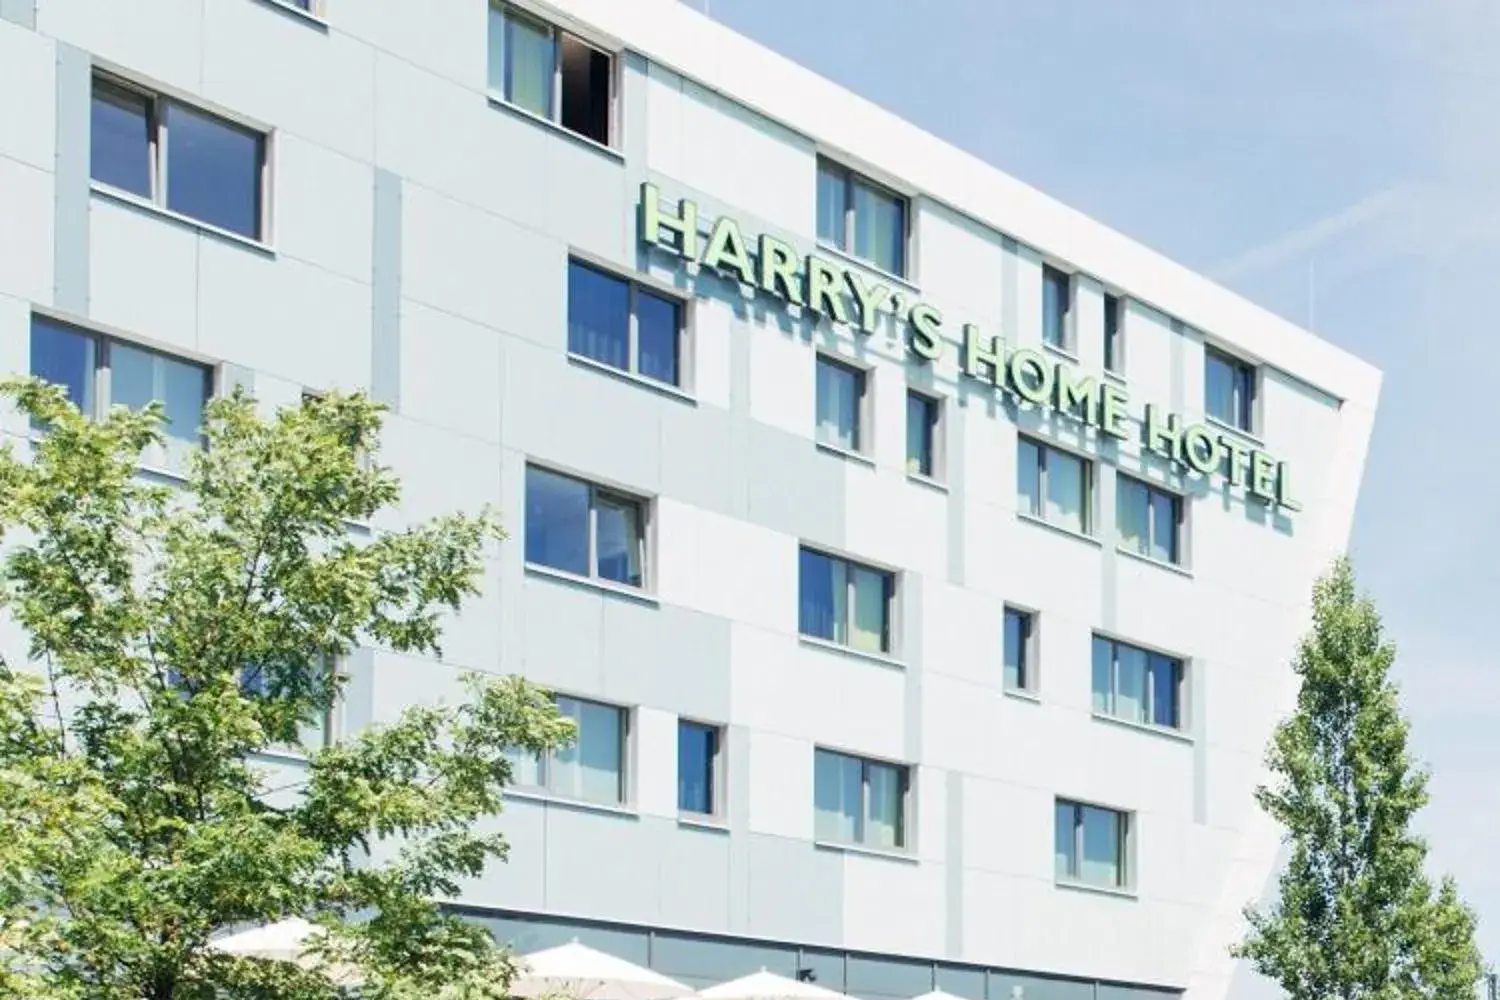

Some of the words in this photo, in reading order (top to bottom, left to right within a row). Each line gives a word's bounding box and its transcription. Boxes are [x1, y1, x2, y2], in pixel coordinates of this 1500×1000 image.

[640, 182, 946, 361] HARRY'S
[963, 322, 1134, 441] HOME
[1144, 402, 1303, 513] HOTEL
